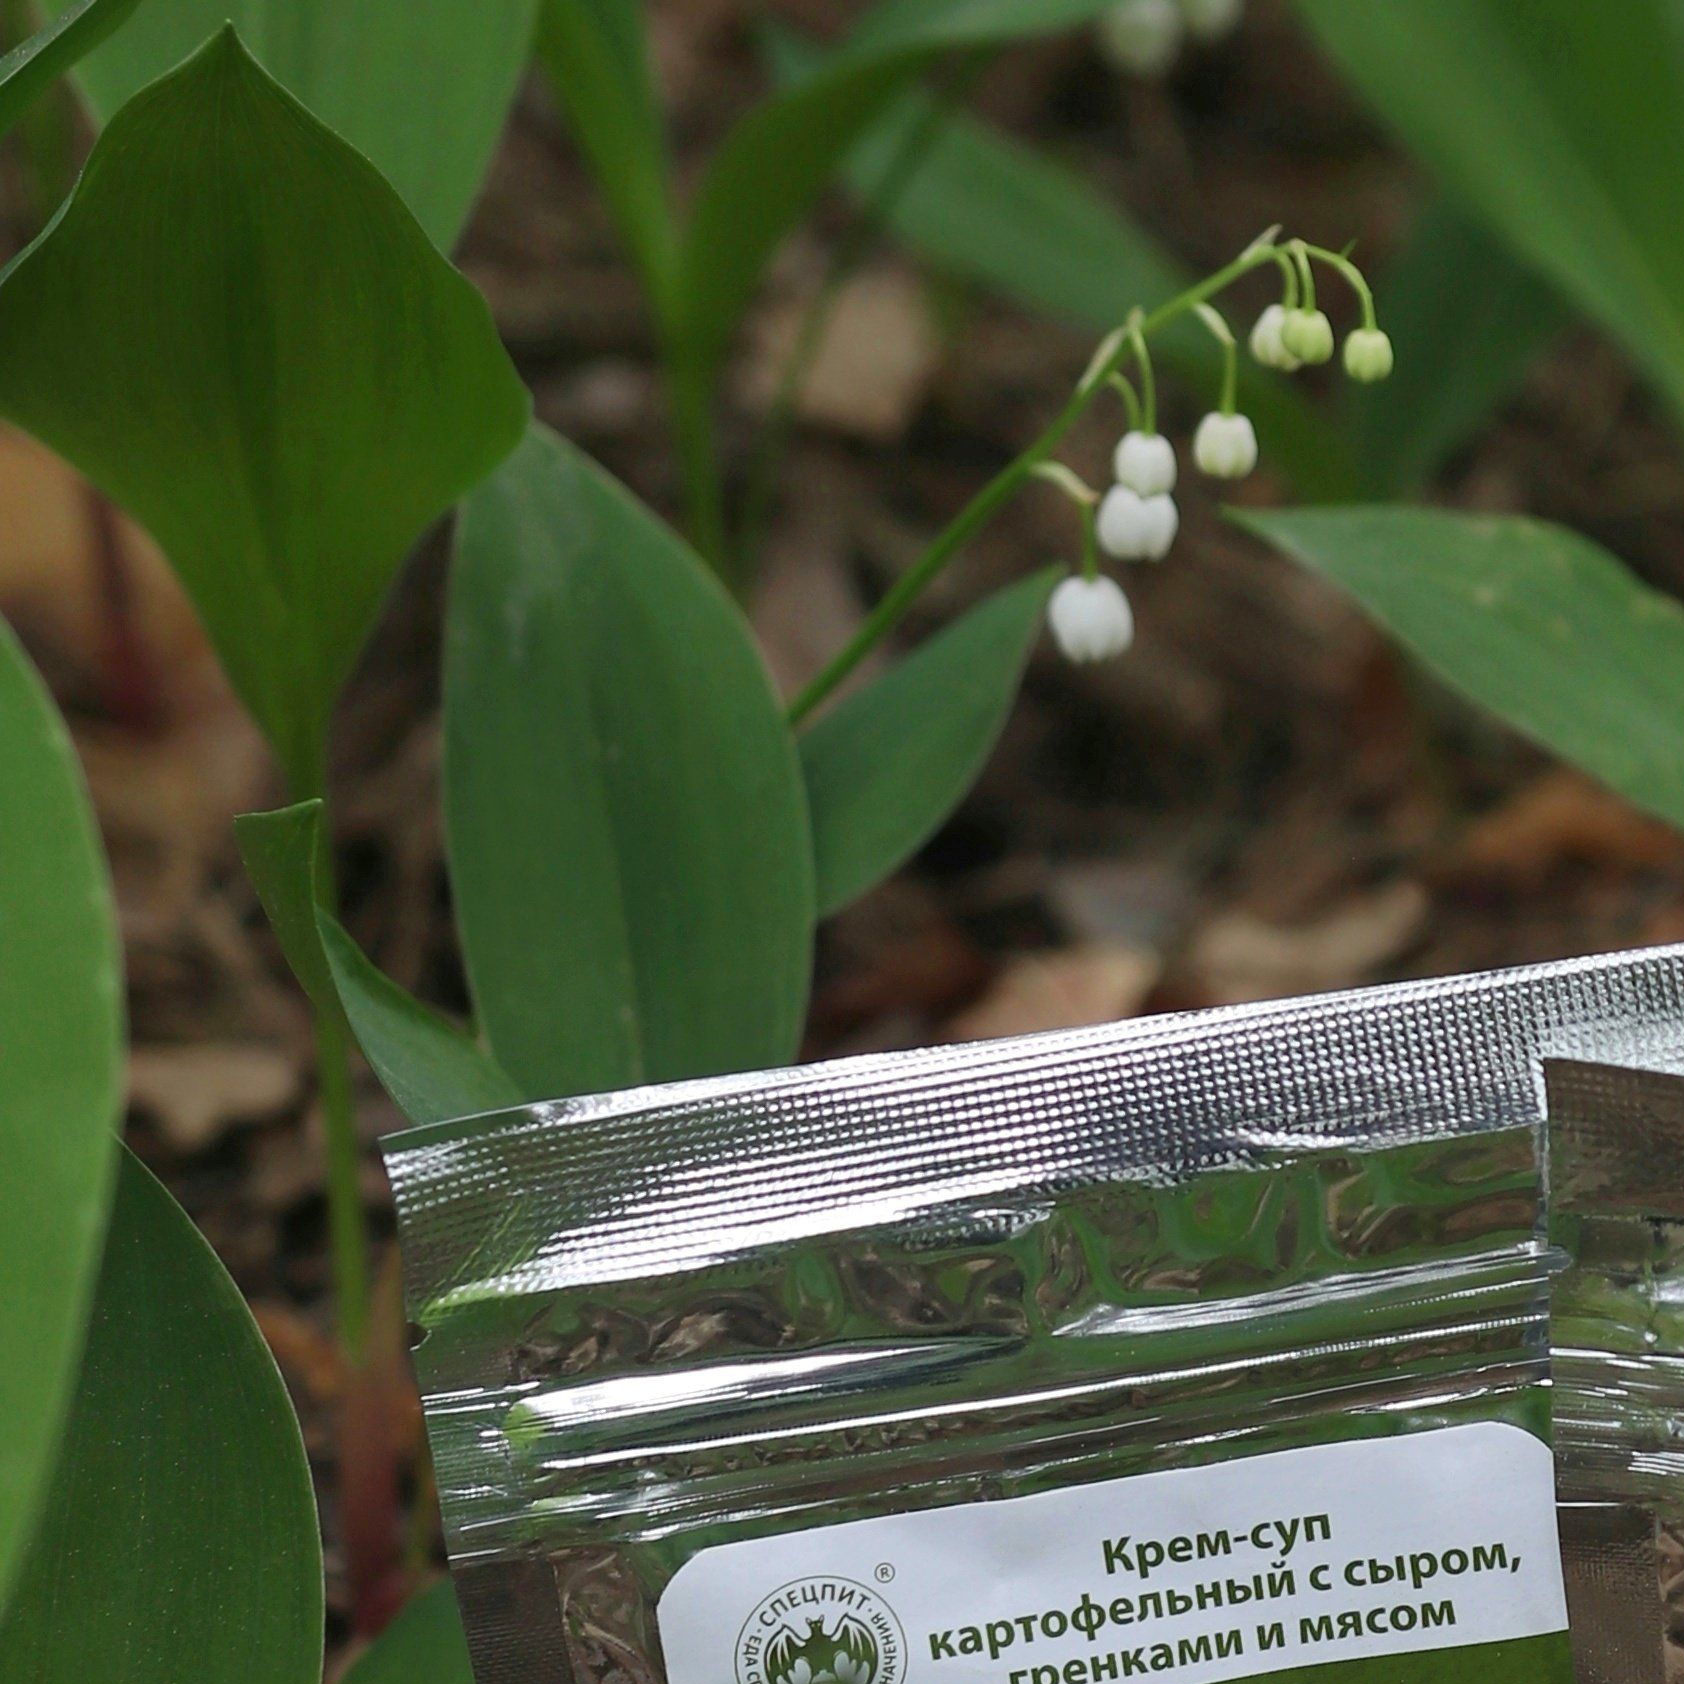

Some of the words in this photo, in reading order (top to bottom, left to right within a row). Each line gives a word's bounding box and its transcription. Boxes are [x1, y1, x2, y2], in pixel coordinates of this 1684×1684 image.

[1102, 1513, 1332, 1578] Крем-суп
[760, 1584, 871, 1627] СПЕЦПИТ
[929, 1561, 1296, 1660] картофельный
[1309, 1564, 1333, 1591] с
[1345, 1543, 1522, 1589] сыром,
[1258, 1623, 1285, 1649] и
[1299, 1601, 1455, 1643] мясом
[743, 1635, 762, 1667] ЕДА
